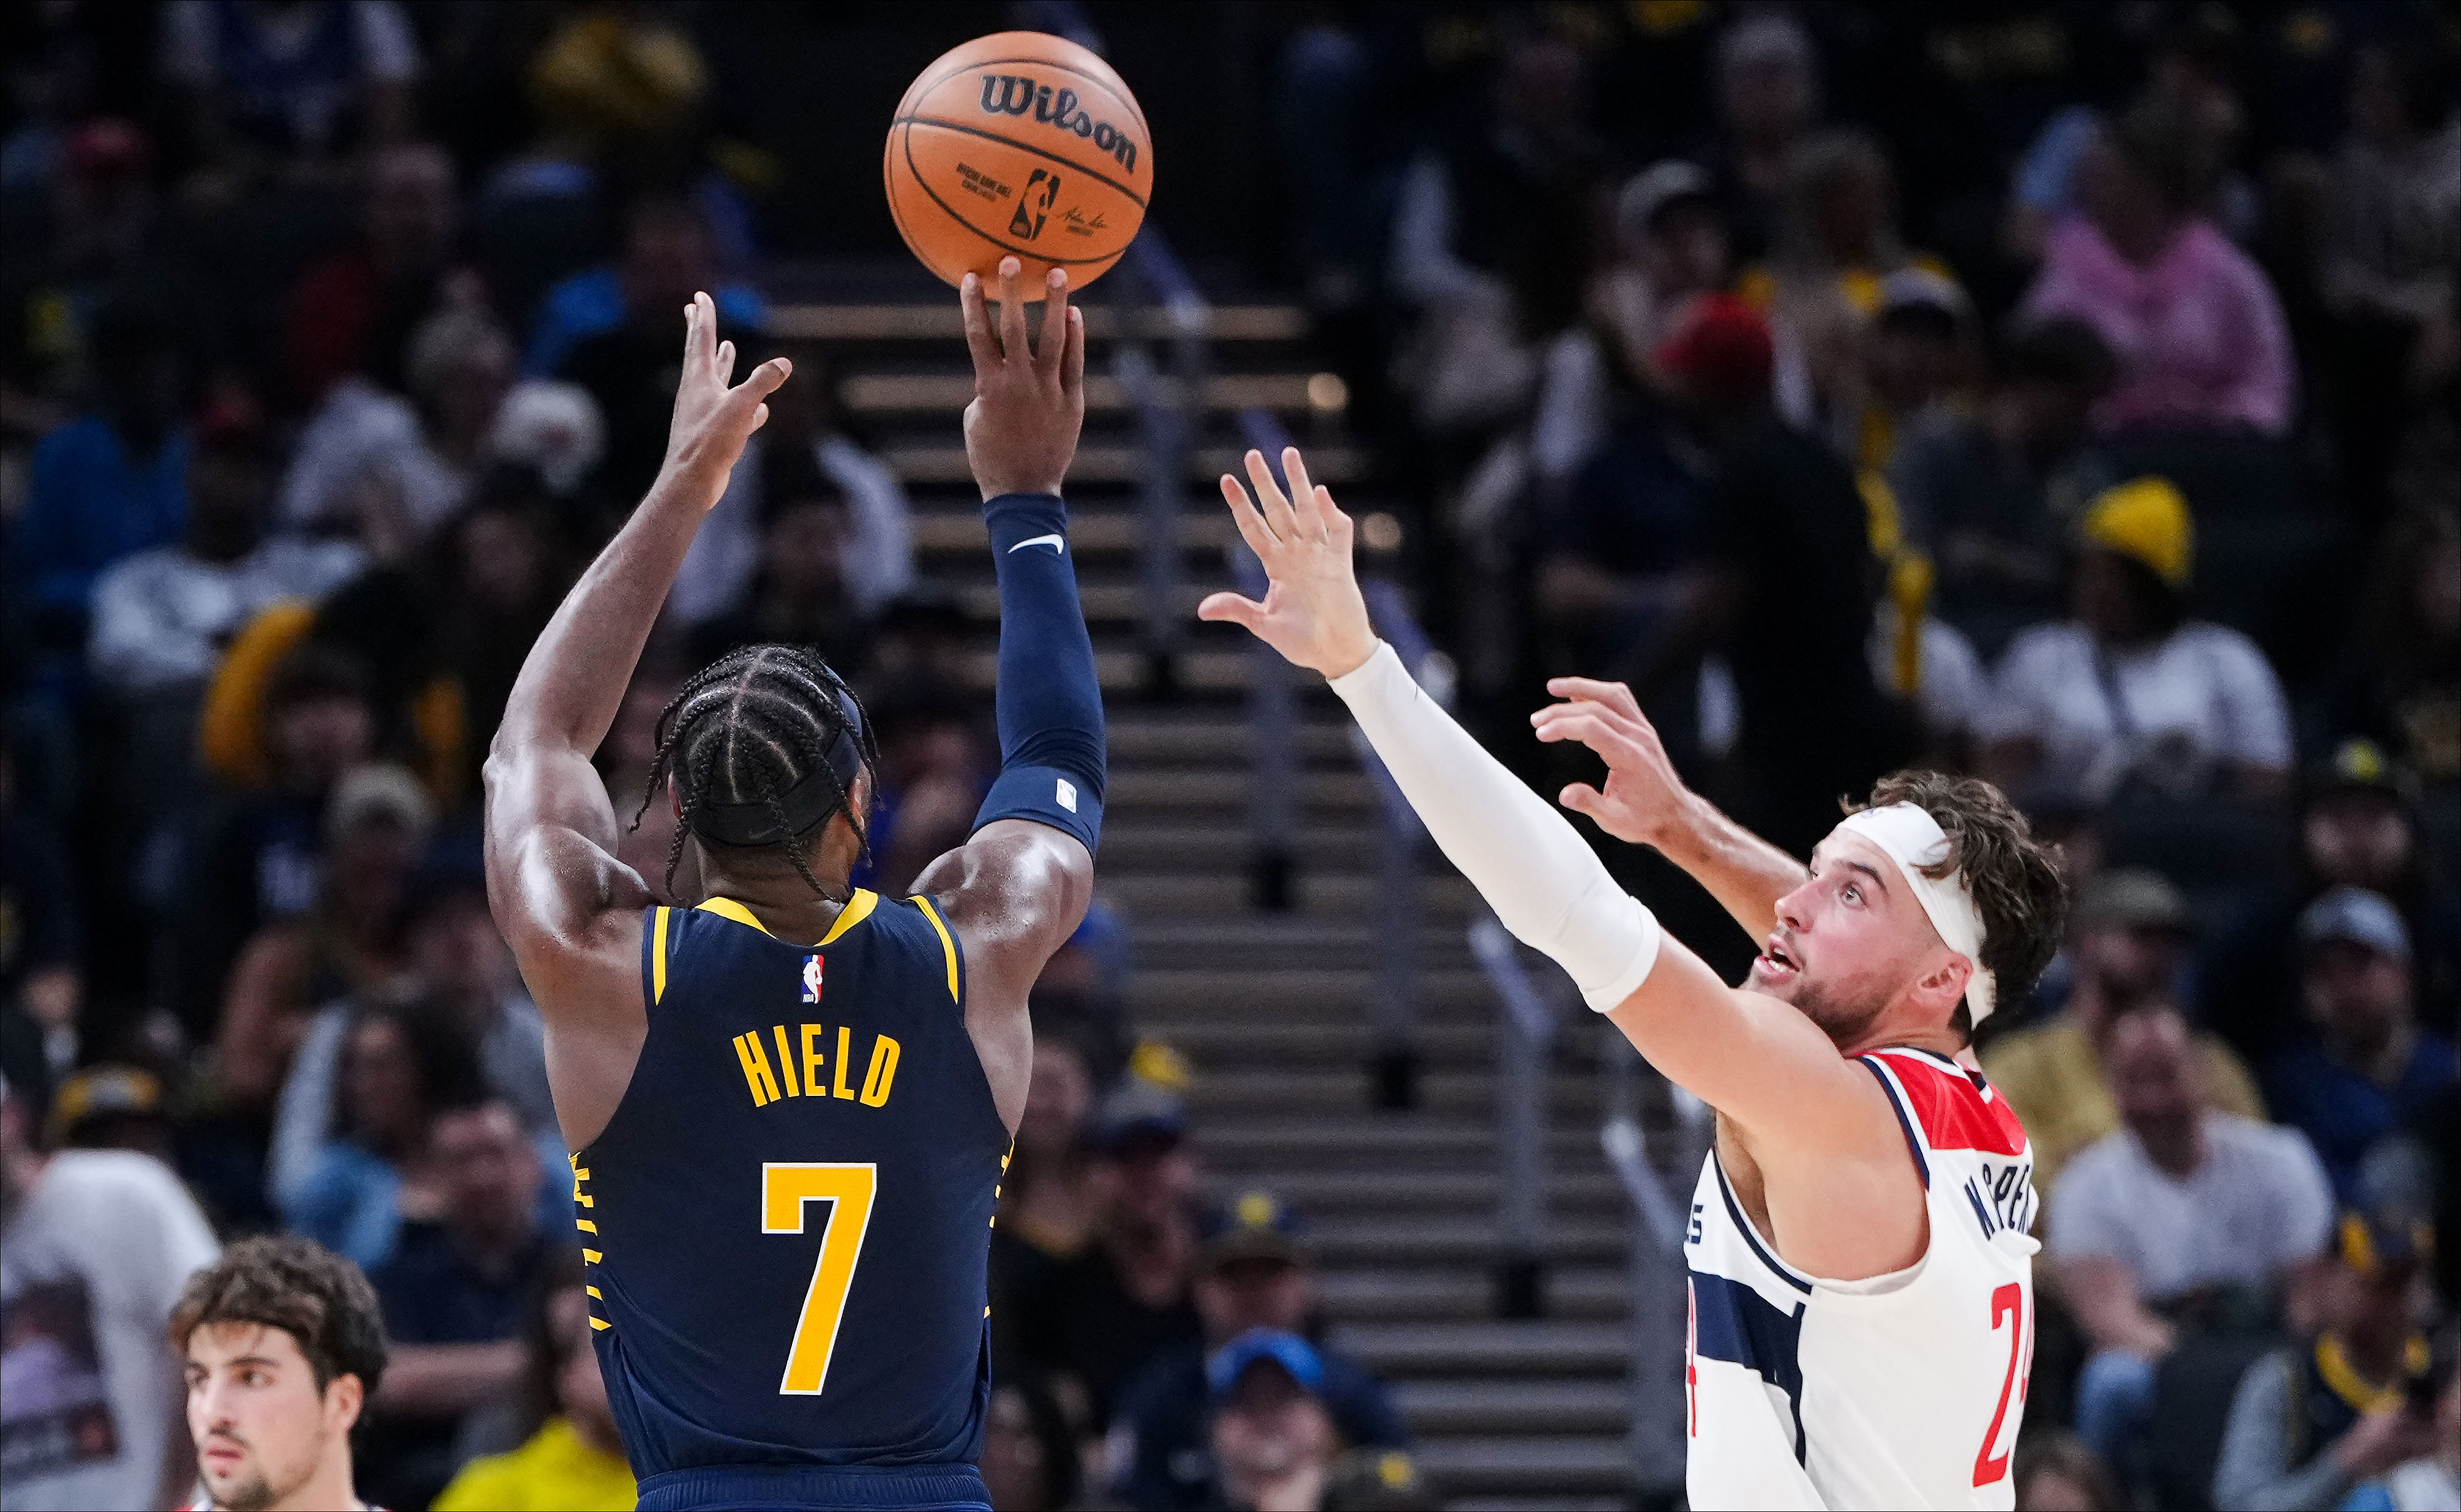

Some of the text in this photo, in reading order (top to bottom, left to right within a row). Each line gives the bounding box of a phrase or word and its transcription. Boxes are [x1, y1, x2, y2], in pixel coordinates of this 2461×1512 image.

[980, 75, 1137, 174] Wilson
[732, 1024, 901, 1108] HIELD
[761, 1162, 877, 1396] 7
[1973, 1282, 2034, 1488] 2
